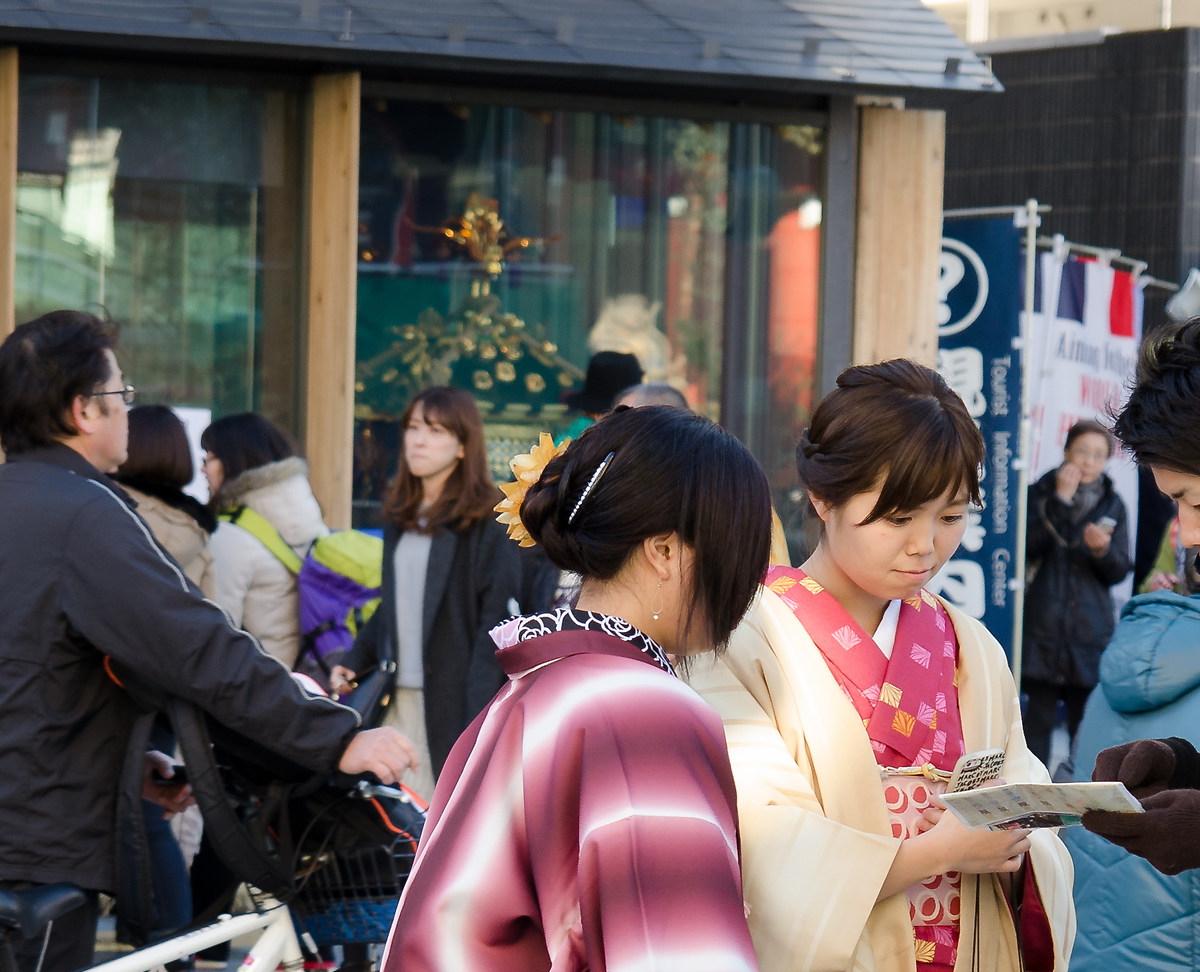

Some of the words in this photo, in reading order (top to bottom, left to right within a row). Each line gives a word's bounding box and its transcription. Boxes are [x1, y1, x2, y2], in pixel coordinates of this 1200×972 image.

[991, 354, 1012, 416] Tourist
[991, 431, 1012, 534] Information
[991, 548, 1011, 608] Center
